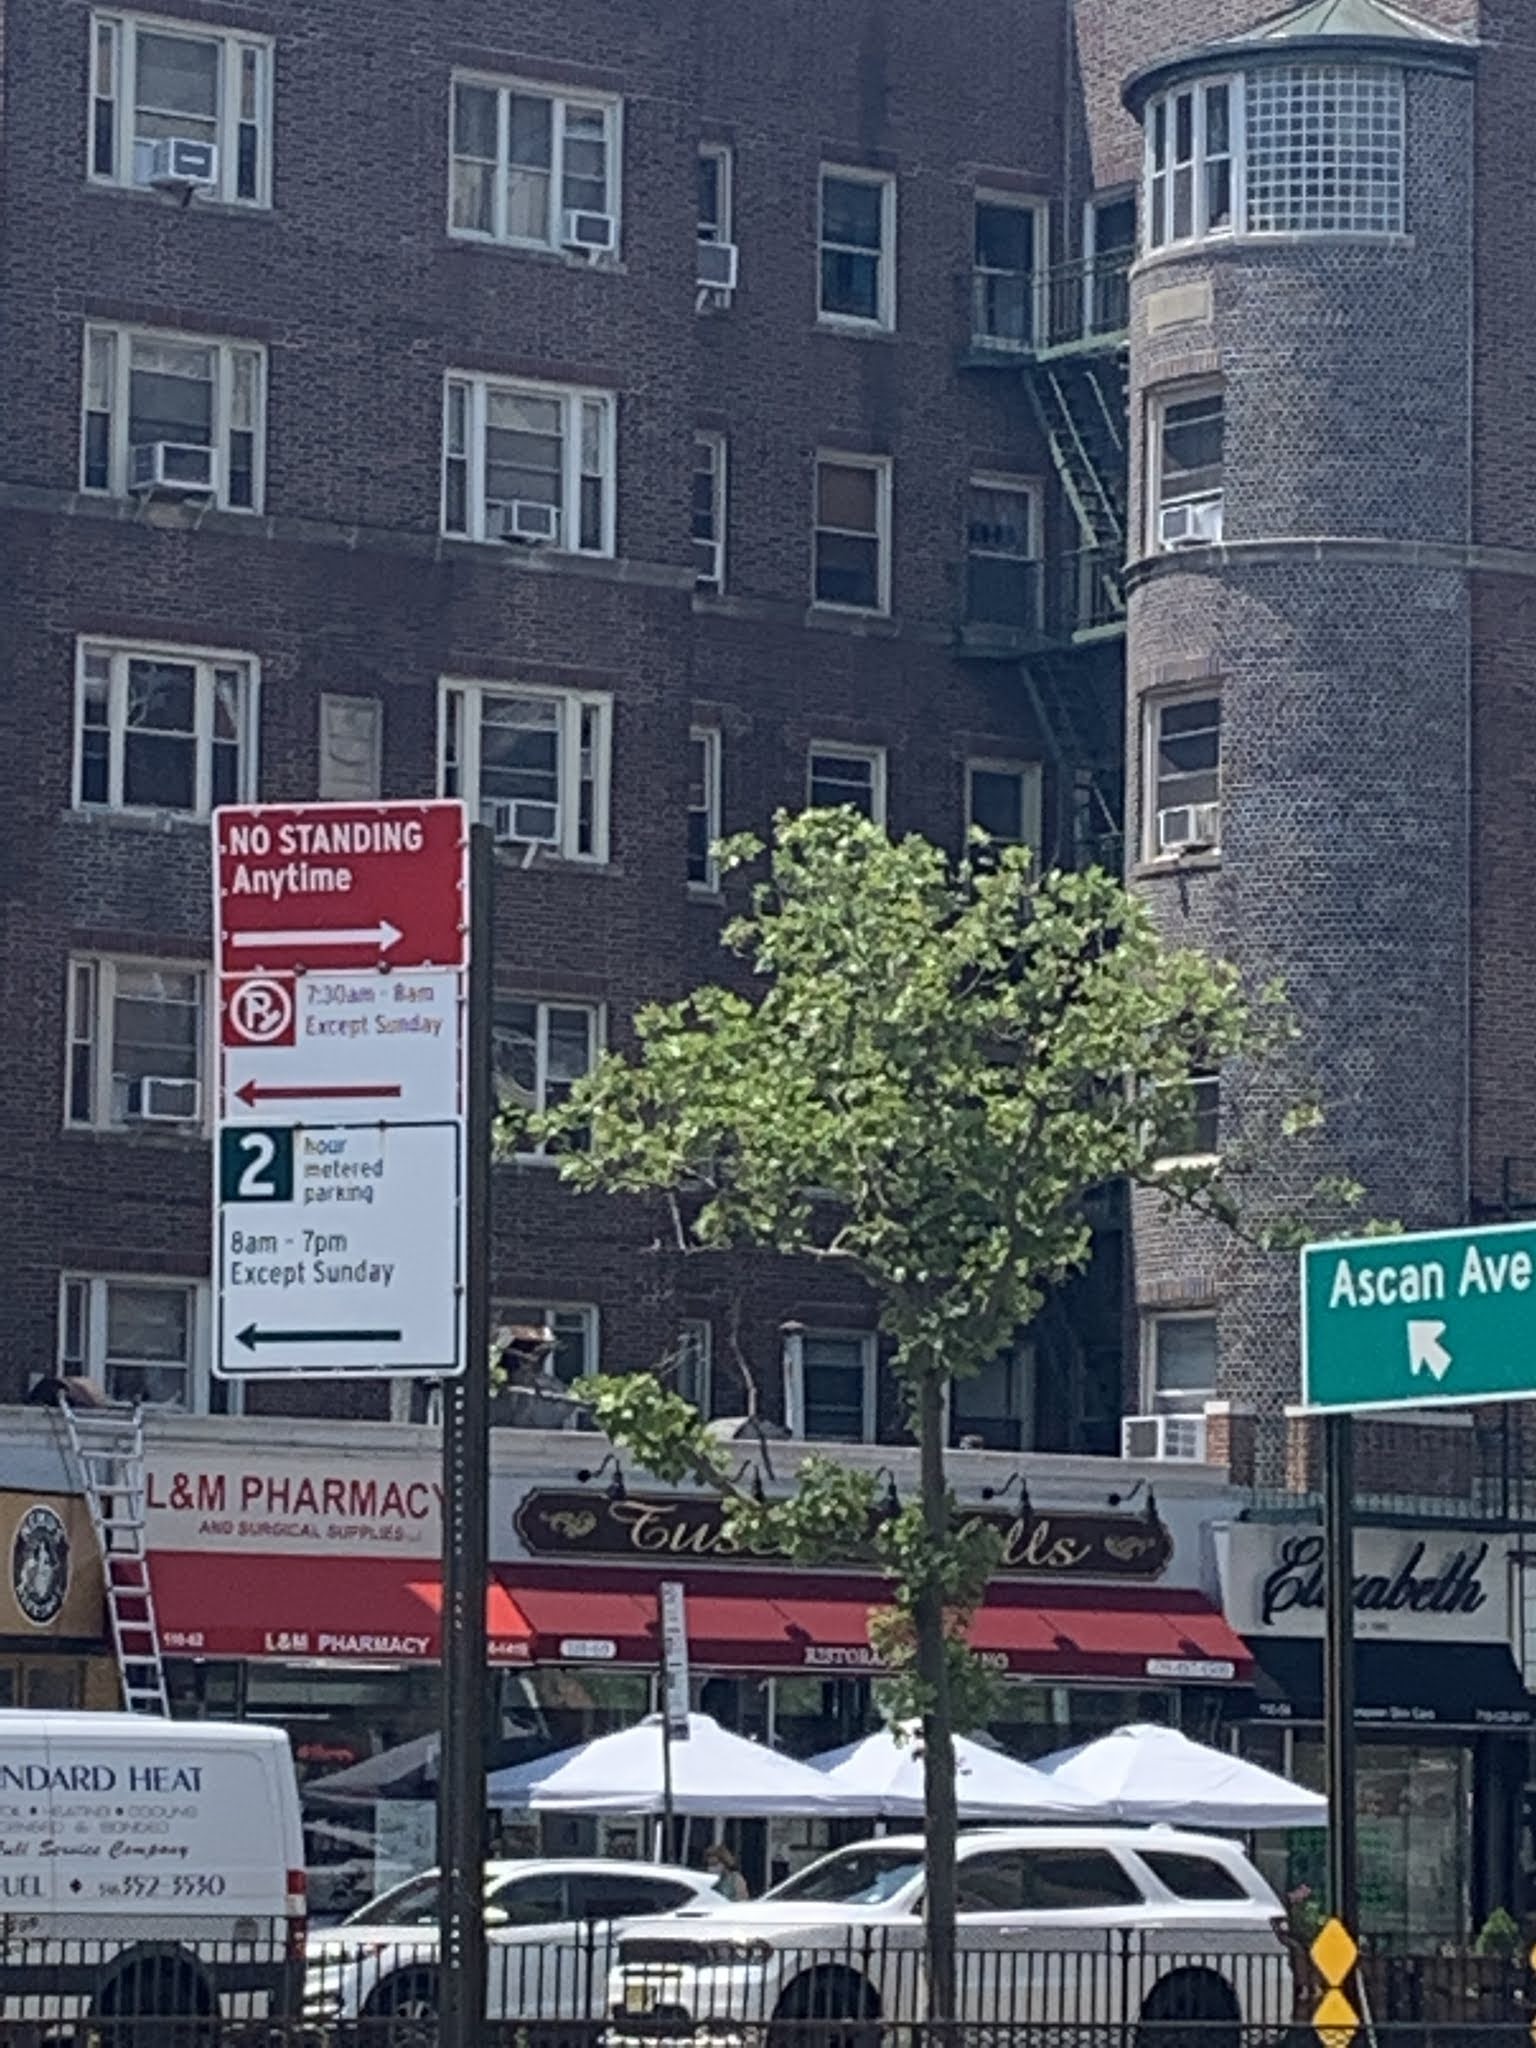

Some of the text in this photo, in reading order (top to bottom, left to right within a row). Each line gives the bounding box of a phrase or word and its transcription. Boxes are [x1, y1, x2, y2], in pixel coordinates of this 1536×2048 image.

[229, 821, 423, 855] NO STANDING
[231, 862, 353, 900] Anytime
[305, 1013, 442, 1038] Except Sunday
[303, 1136, 348, 1155] hour
[237, 1132, 276, 1196] 2
[303, 1159, 384, 1179] metered
[303, 1184, 374, 1205] parking
[230, 1230, 278, 1255] 8am
[302, 1228, 348, 1257] 7pm
[230, 1259, 395, 1288] Except Sunday
[1328, 1245, 1533, 1308] Ascan Ave
[146, 1472, 226, 1512] L&M
[199, 1520, 234, 1536] AND
[238, 1521, 322, 1540] SURGICAL
[326, 1523, 404, 1541] SUPPLIES
[264, 1631, 431, 1654] L&M PHARMACY
[0, 1764, 203, 1793] NDARD HEAT
[38, 1840, 101, 1858] Service
[108, 1840, 190, 1861] Company
